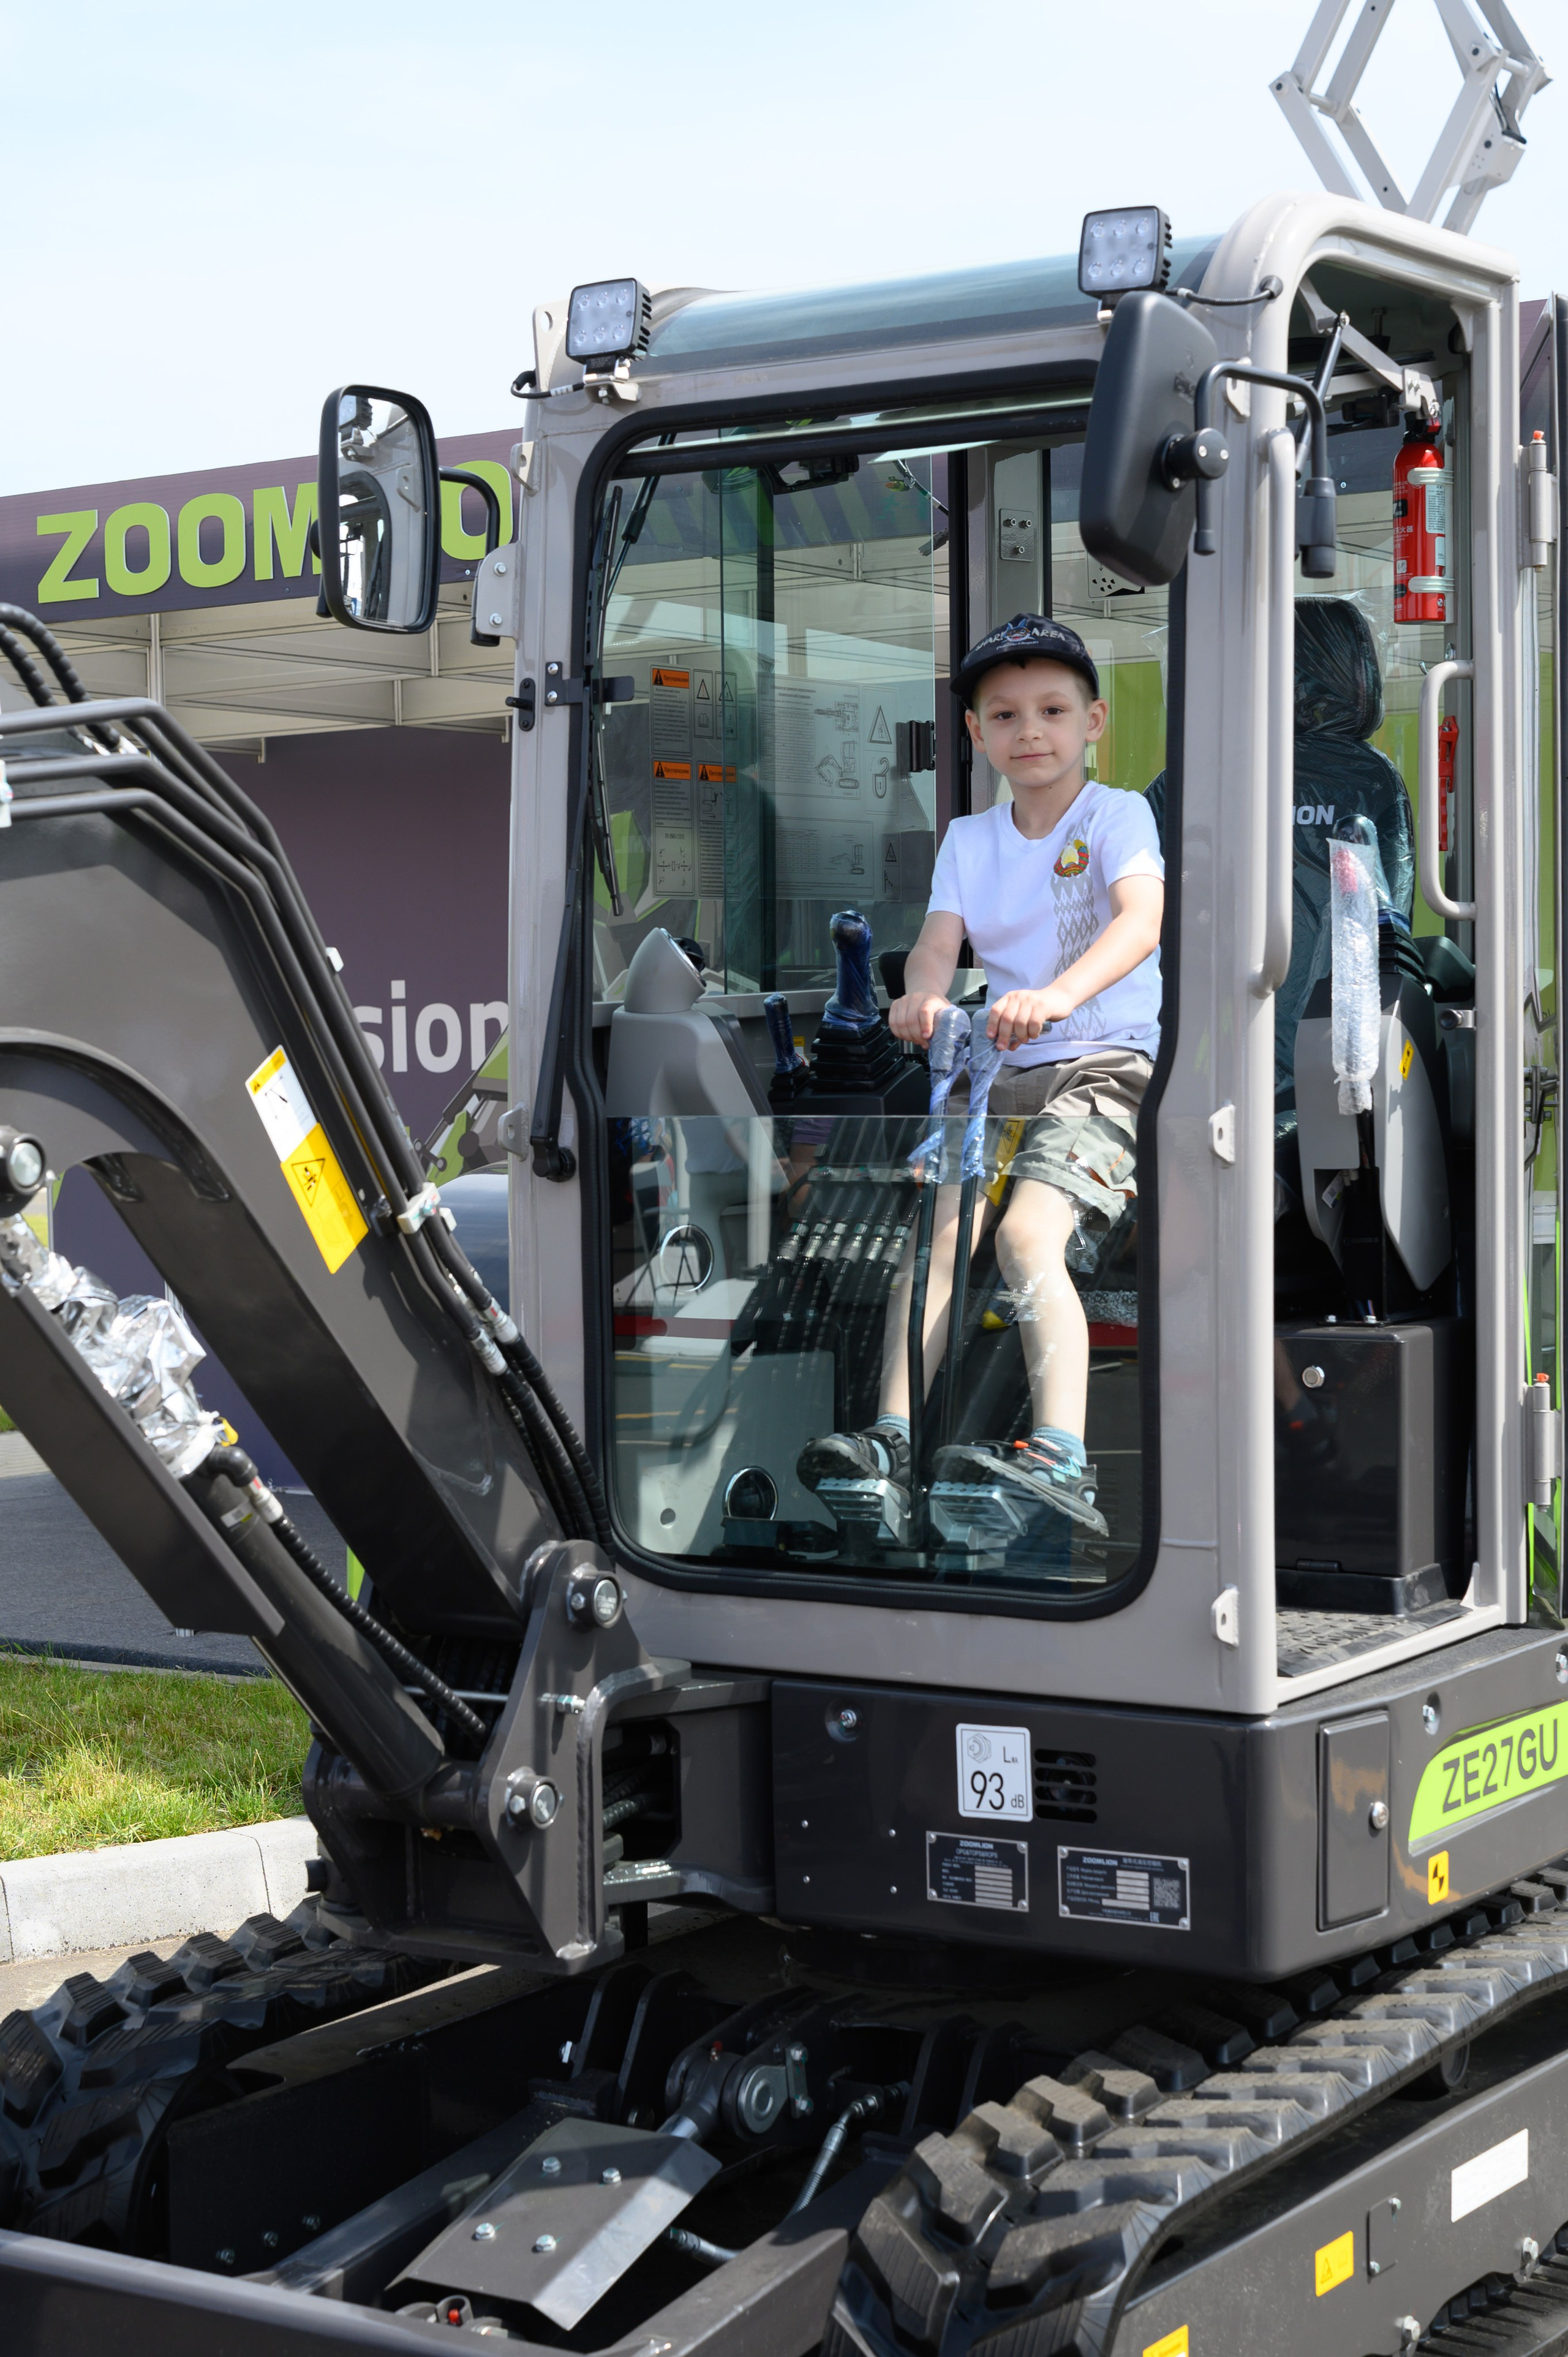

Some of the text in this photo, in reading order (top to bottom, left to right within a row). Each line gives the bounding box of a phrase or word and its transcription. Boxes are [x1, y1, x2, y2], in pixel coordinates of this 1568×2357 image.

[1031, 628, 1065, 641] AREA
[1442, 1719, 1558, 1813] ZE27GU
[971, 1770, 1025, 1810] 93 dB
[959, 1840, 994, 1850] ZOOMLION
[1082, 1857, 1118, 1867] ZOOMLION
